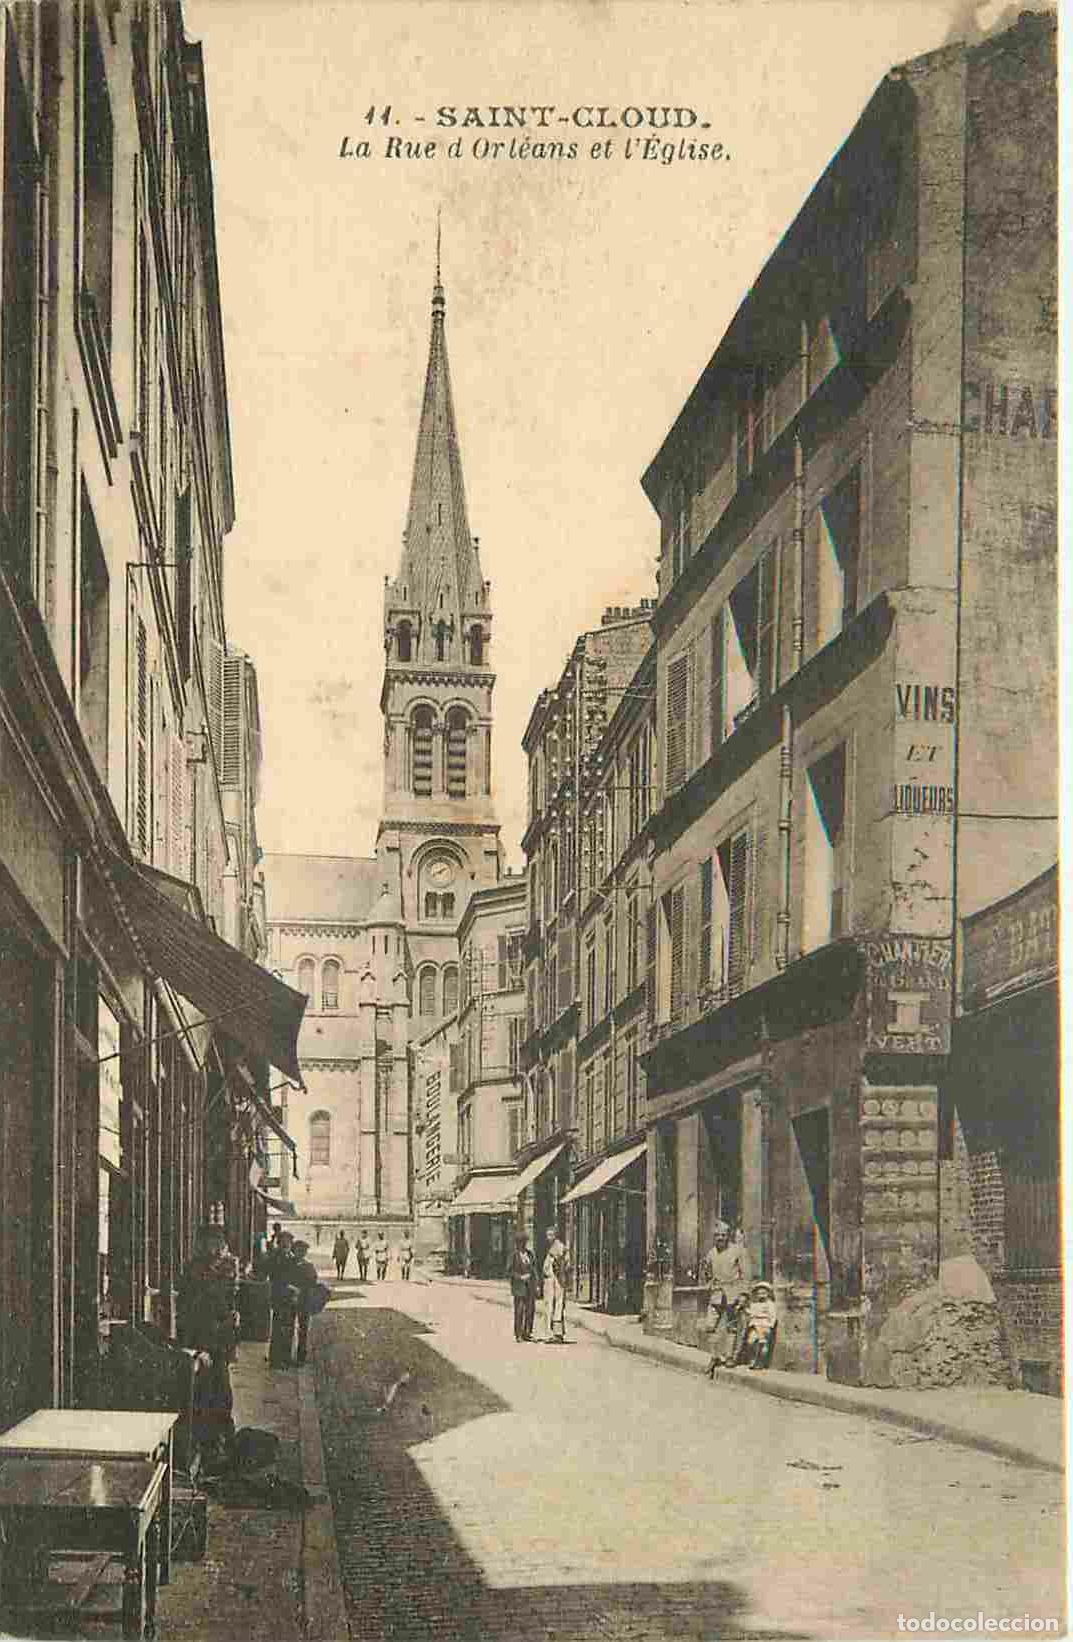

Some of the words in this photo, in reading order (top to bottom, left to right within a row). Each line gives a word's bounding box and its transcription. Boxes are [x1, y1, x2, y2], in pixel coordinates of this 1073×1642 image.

[895, 684, 956, 722] VINS
[906, 743, 942, 761] ET
[893, 783, 955, 815] LIQUEURS
[426, 1071, 442, 1187] BOULANGERIE
